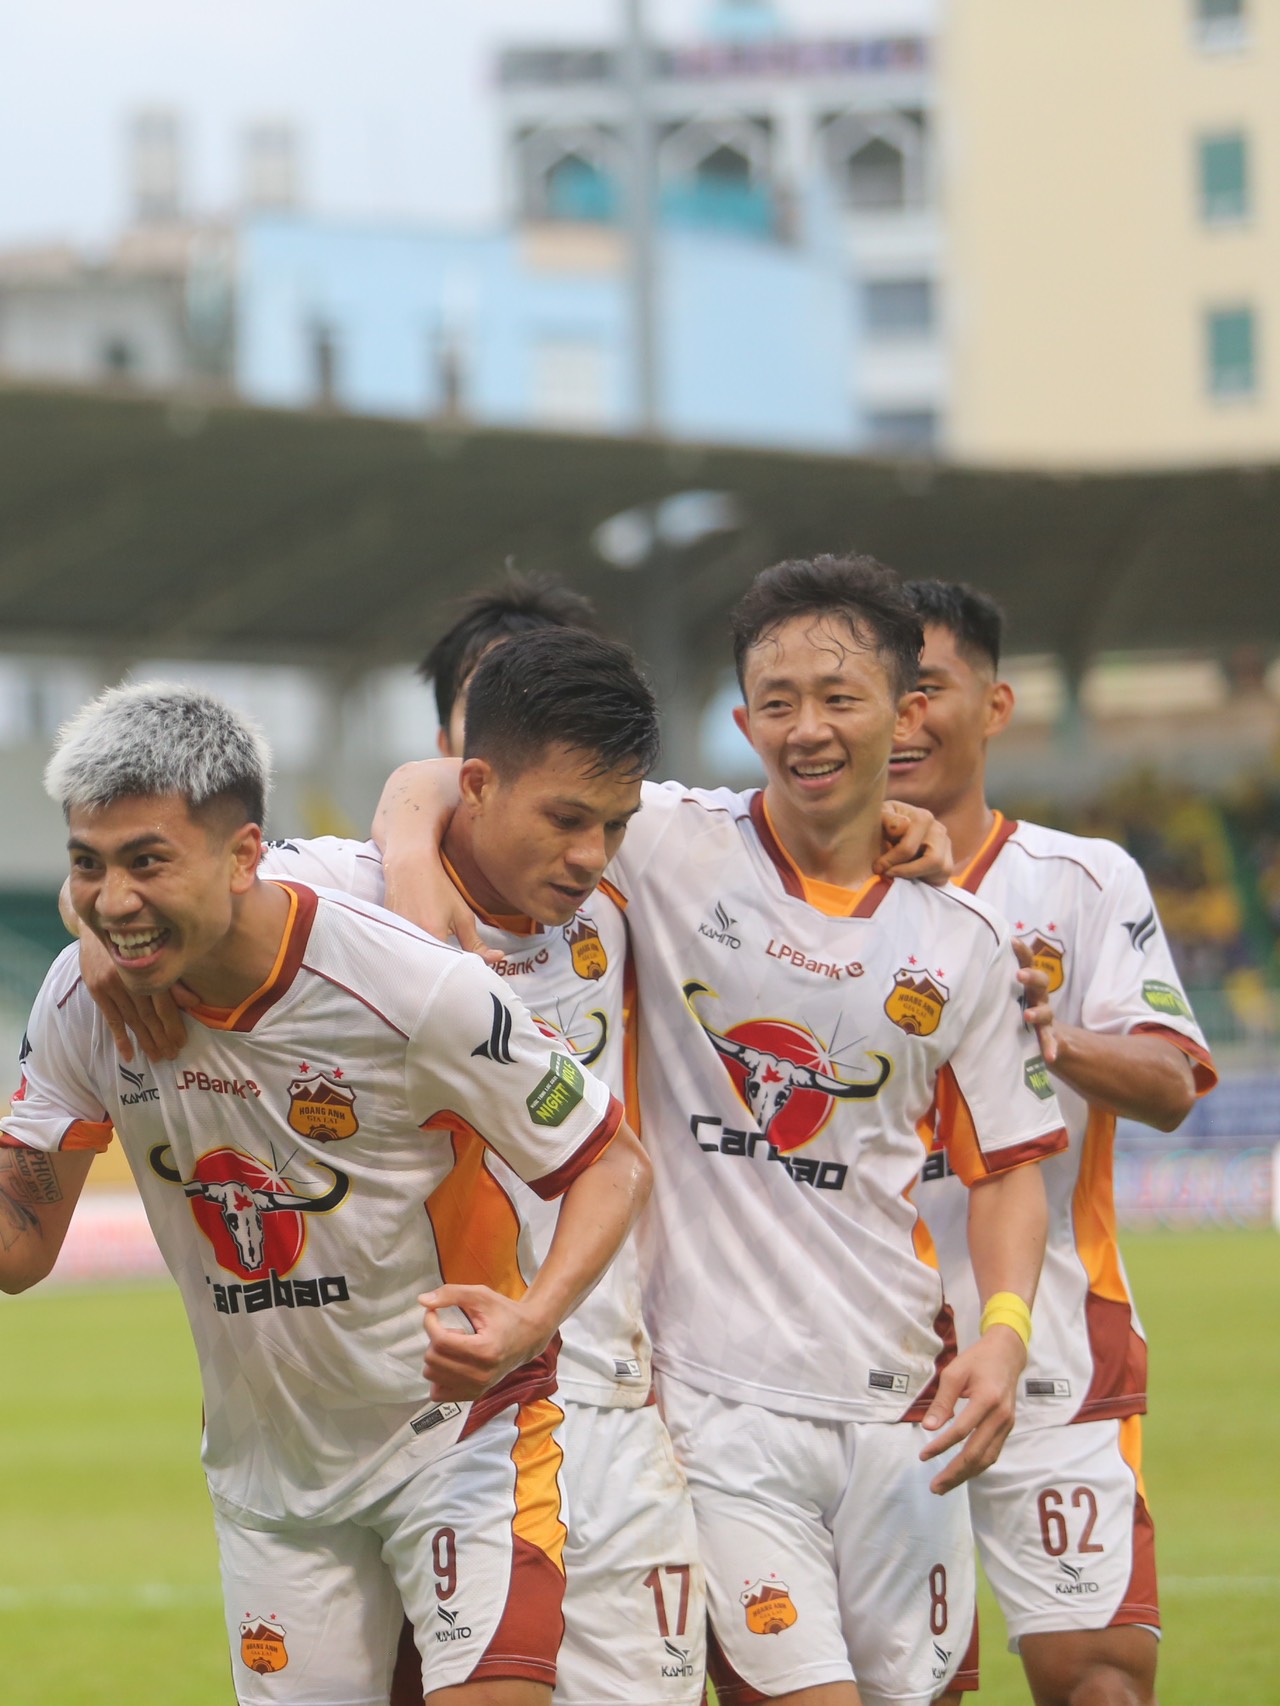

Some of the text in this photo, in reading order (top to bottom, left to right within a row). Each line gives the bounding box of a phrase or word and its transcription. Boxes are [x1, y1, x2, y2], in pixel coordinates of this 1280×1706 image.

[698, 922, 742, 950] KAMITO
[765, 938, 844, 981] LPBank
[299, 1105, 346, 1121] HOANG ANH
[535, 1082, 571, 1122] NIGHT
[205, 1268, 351, 1315] arabao
[1036, 1485, 1105, 1557] 62
[431, 1526, 458, 1601] 9
[642, 1563, 690, 1638] 17
[928, 1562, 948, 1636] 8
[1055, 1582, 1100, 1594] KAMITO
